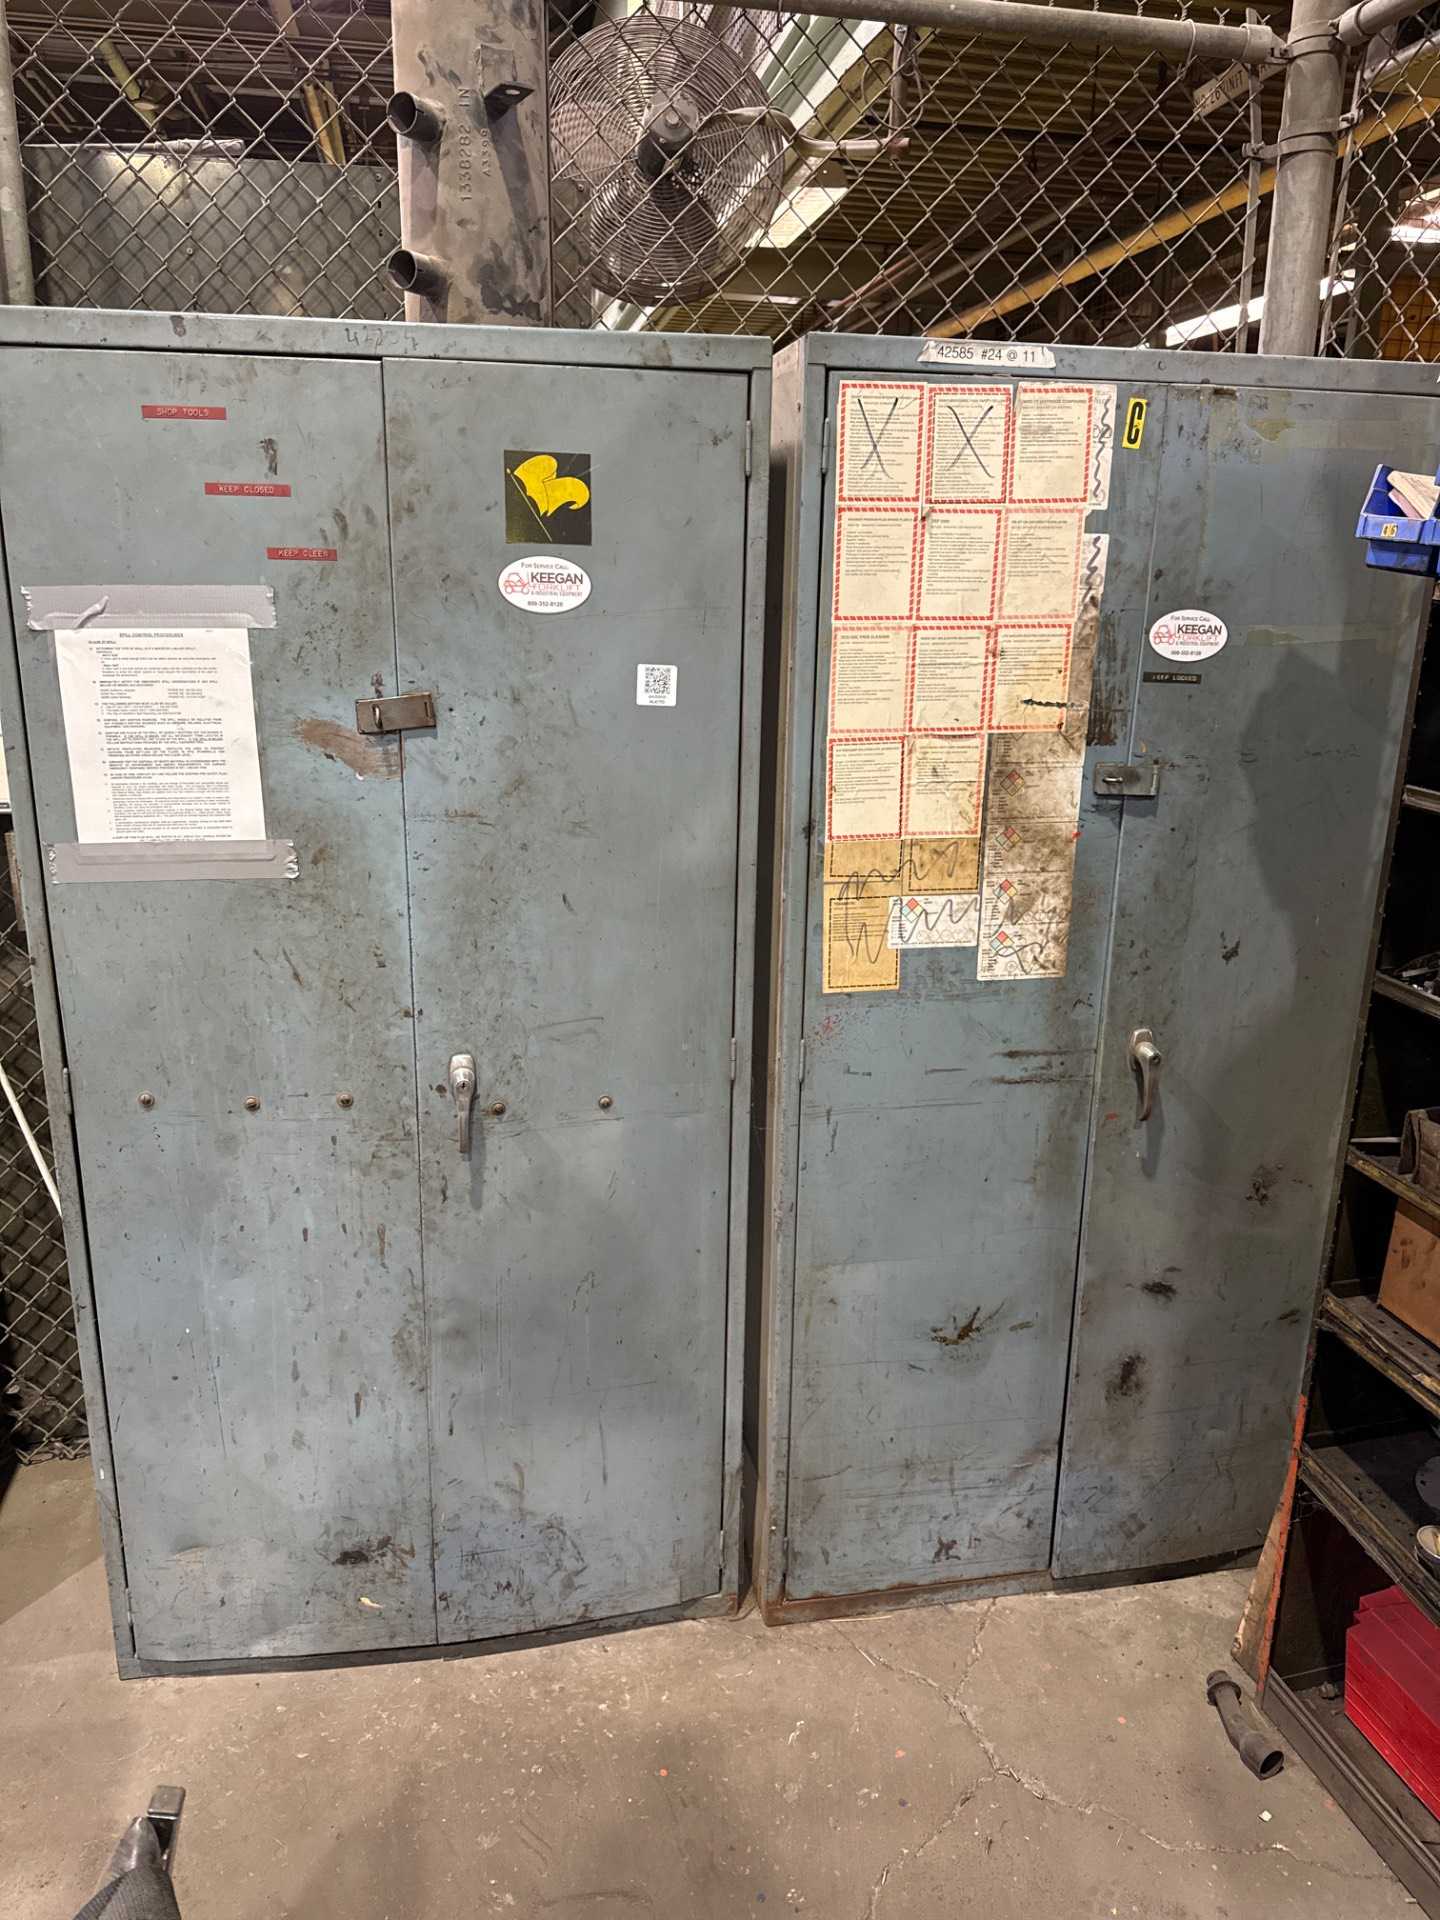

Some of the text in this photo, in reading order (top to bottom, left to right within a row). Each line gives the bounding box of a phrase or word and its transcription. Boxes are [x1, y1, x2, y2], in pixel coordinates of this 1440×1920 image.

[937, 346, 1036, 362] 42585 #24 @ 11
[156, 407, 209, 417] SHOP TOOLS
[1126, 401, 1145, 445] C
[218, 485, 274, 494] KEEP CLOSED
[278, 549, 299, 557] KEEP
[530, 572, 584, 585] KEEGAN
[1177, 624, 1222, 635] KEEGAN
